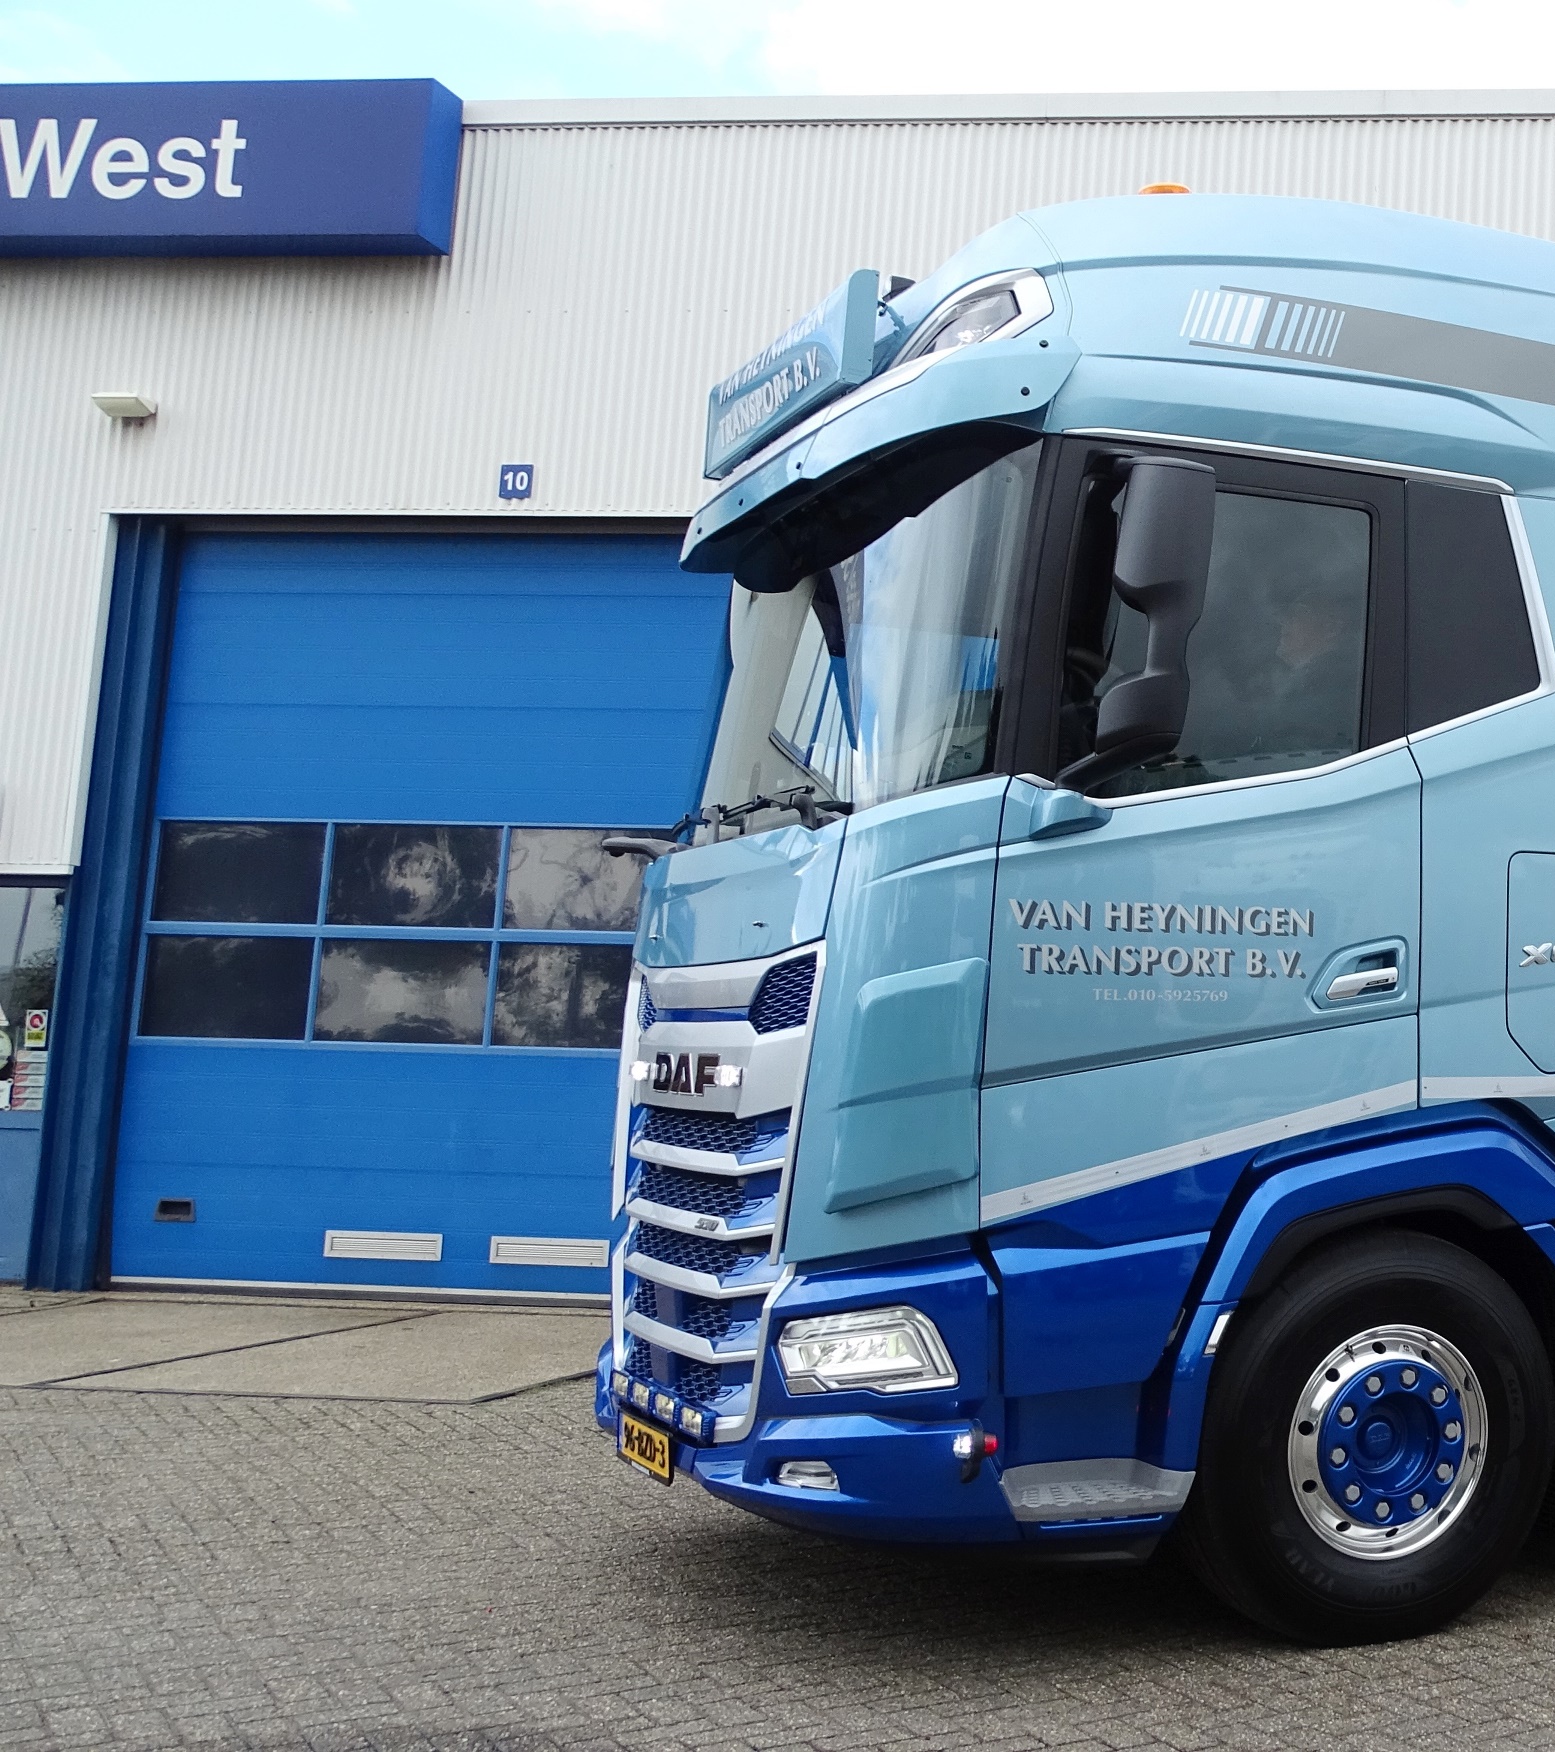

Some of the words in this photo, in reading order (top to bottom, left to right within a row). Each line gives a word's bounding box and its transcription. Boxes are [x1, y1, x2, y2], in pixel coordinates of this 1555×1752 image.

[0, 118, 247, 200] West
[719, 367, 790, 448] TRANSPORT
[503, 471, 529, 491] 10
[1009, 899, 1091, 931] VAN
[1104, 901, 1315, 938] HEYNINGEN
[1017, 944, 1236, 978] TRANSPORT
[653, 1051, 721, 1097] DAF
